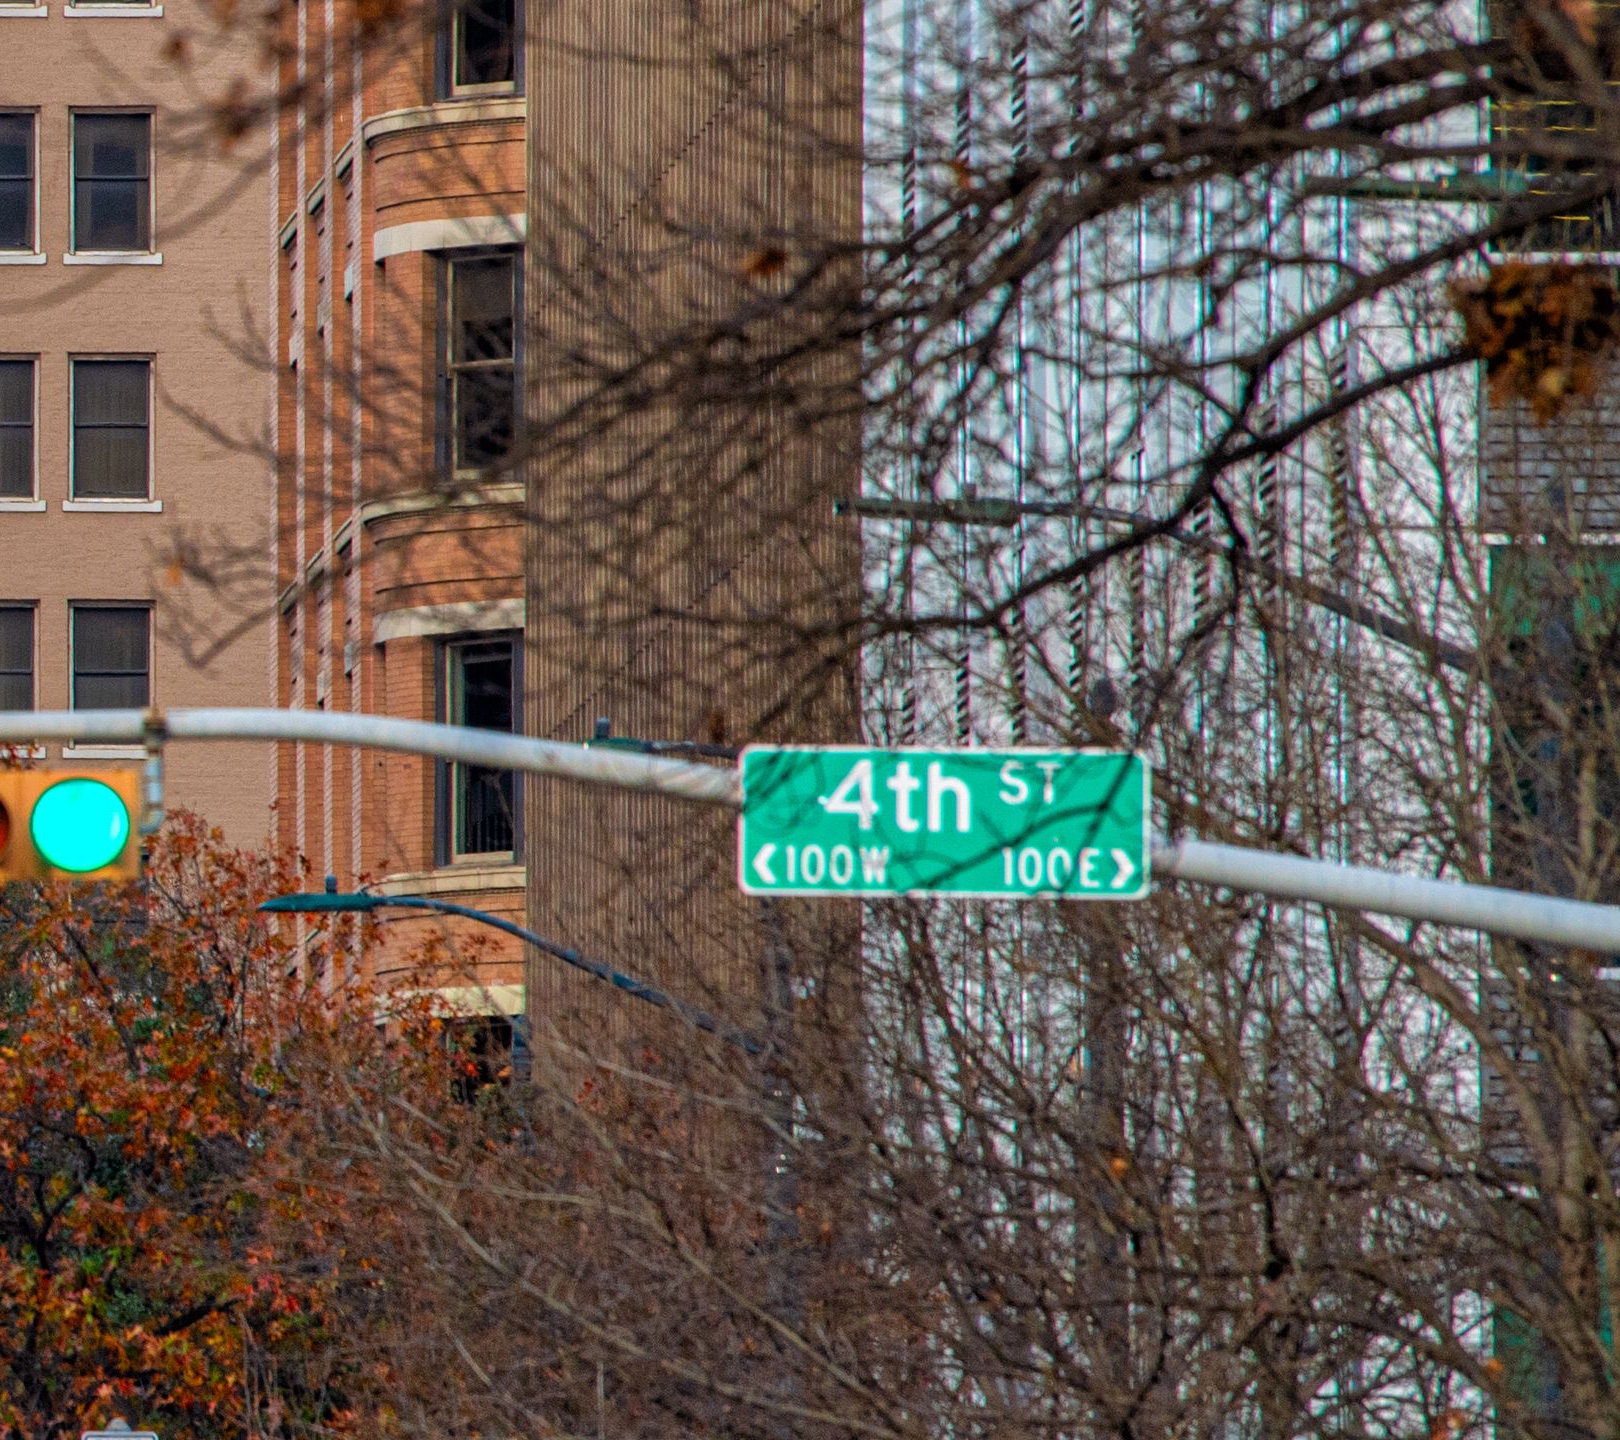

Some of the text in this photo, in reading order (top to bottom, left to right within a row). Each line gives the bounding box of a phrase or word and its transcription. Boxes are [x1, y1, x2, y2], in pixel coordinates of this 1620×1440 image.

[818, 759, 1061, 833] 4th ST
[785, 845, 1100, 889] 100W 100E
